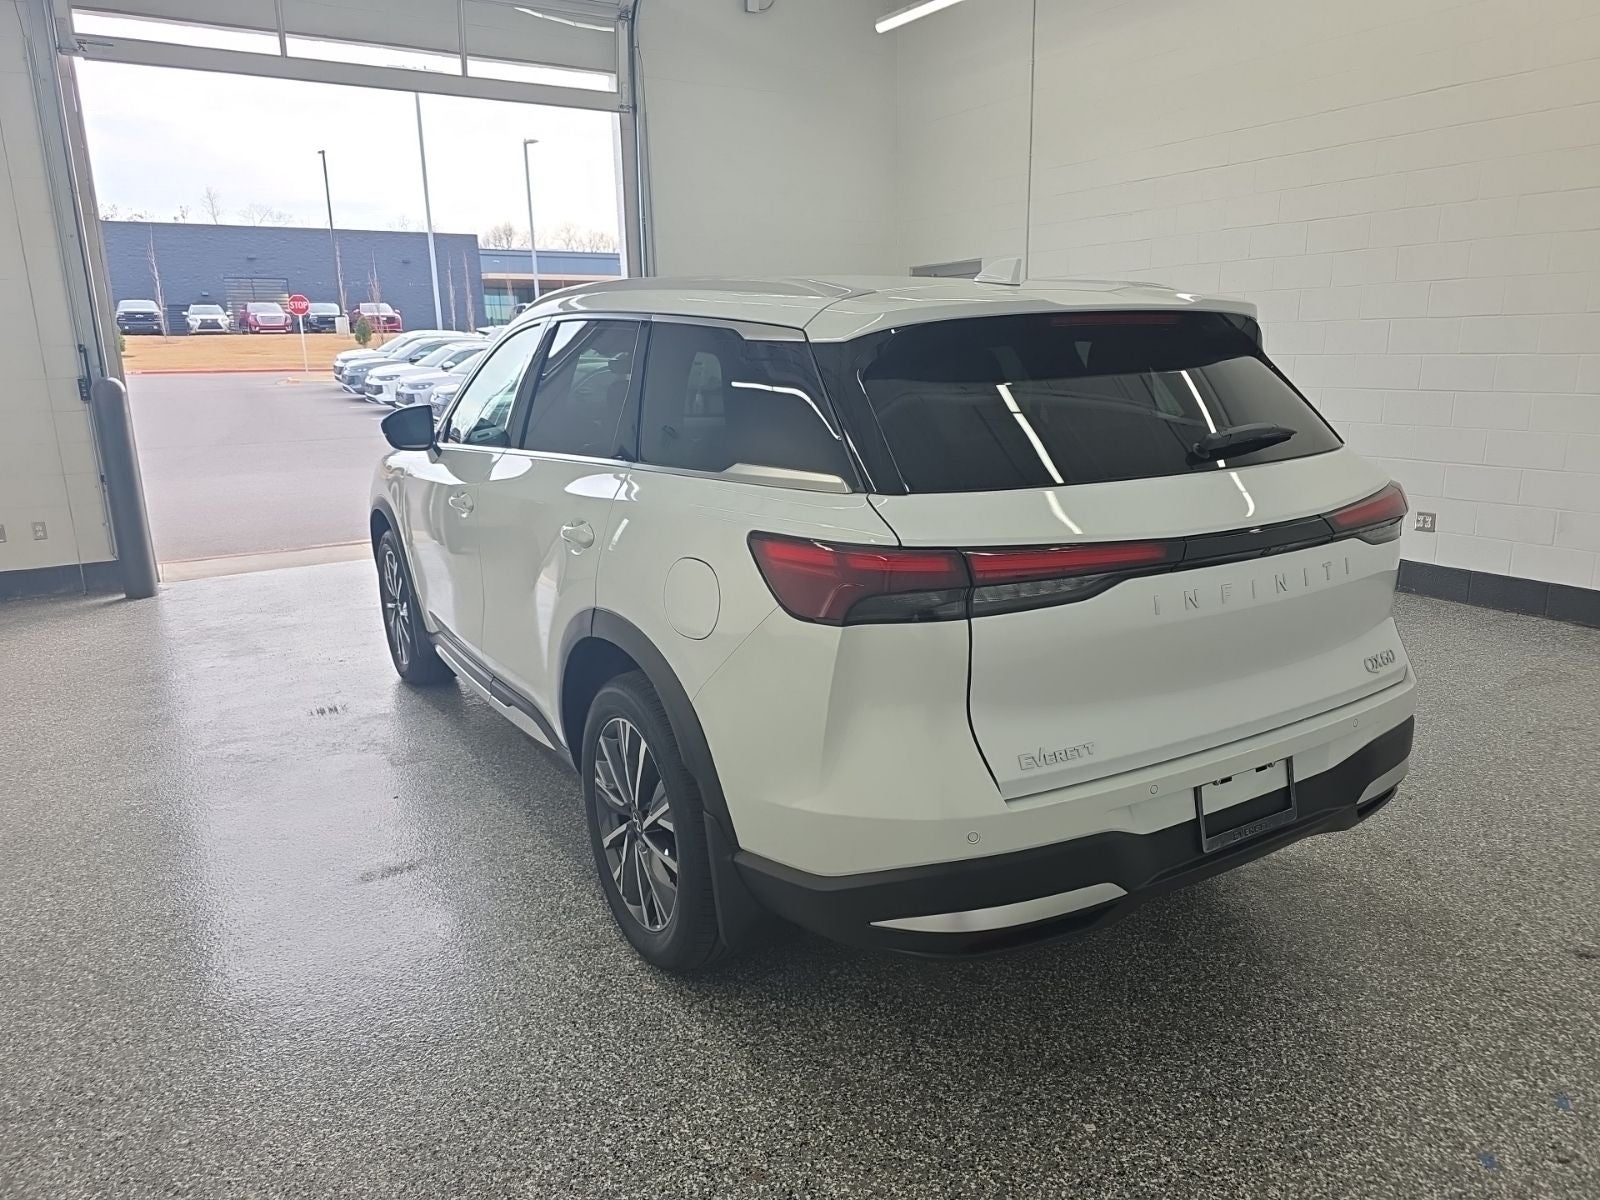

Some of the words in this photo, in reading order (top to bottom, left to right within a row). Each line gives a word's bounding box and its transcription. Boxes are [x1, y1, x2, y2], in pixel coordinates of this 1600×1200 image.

[290, 301, 308, 309] STOP
[1153, 557, 1350, 615] INFINITI
[1363, 649, 1395, 673] QX60
[1017, 741, 1095, 771] EVERETT
